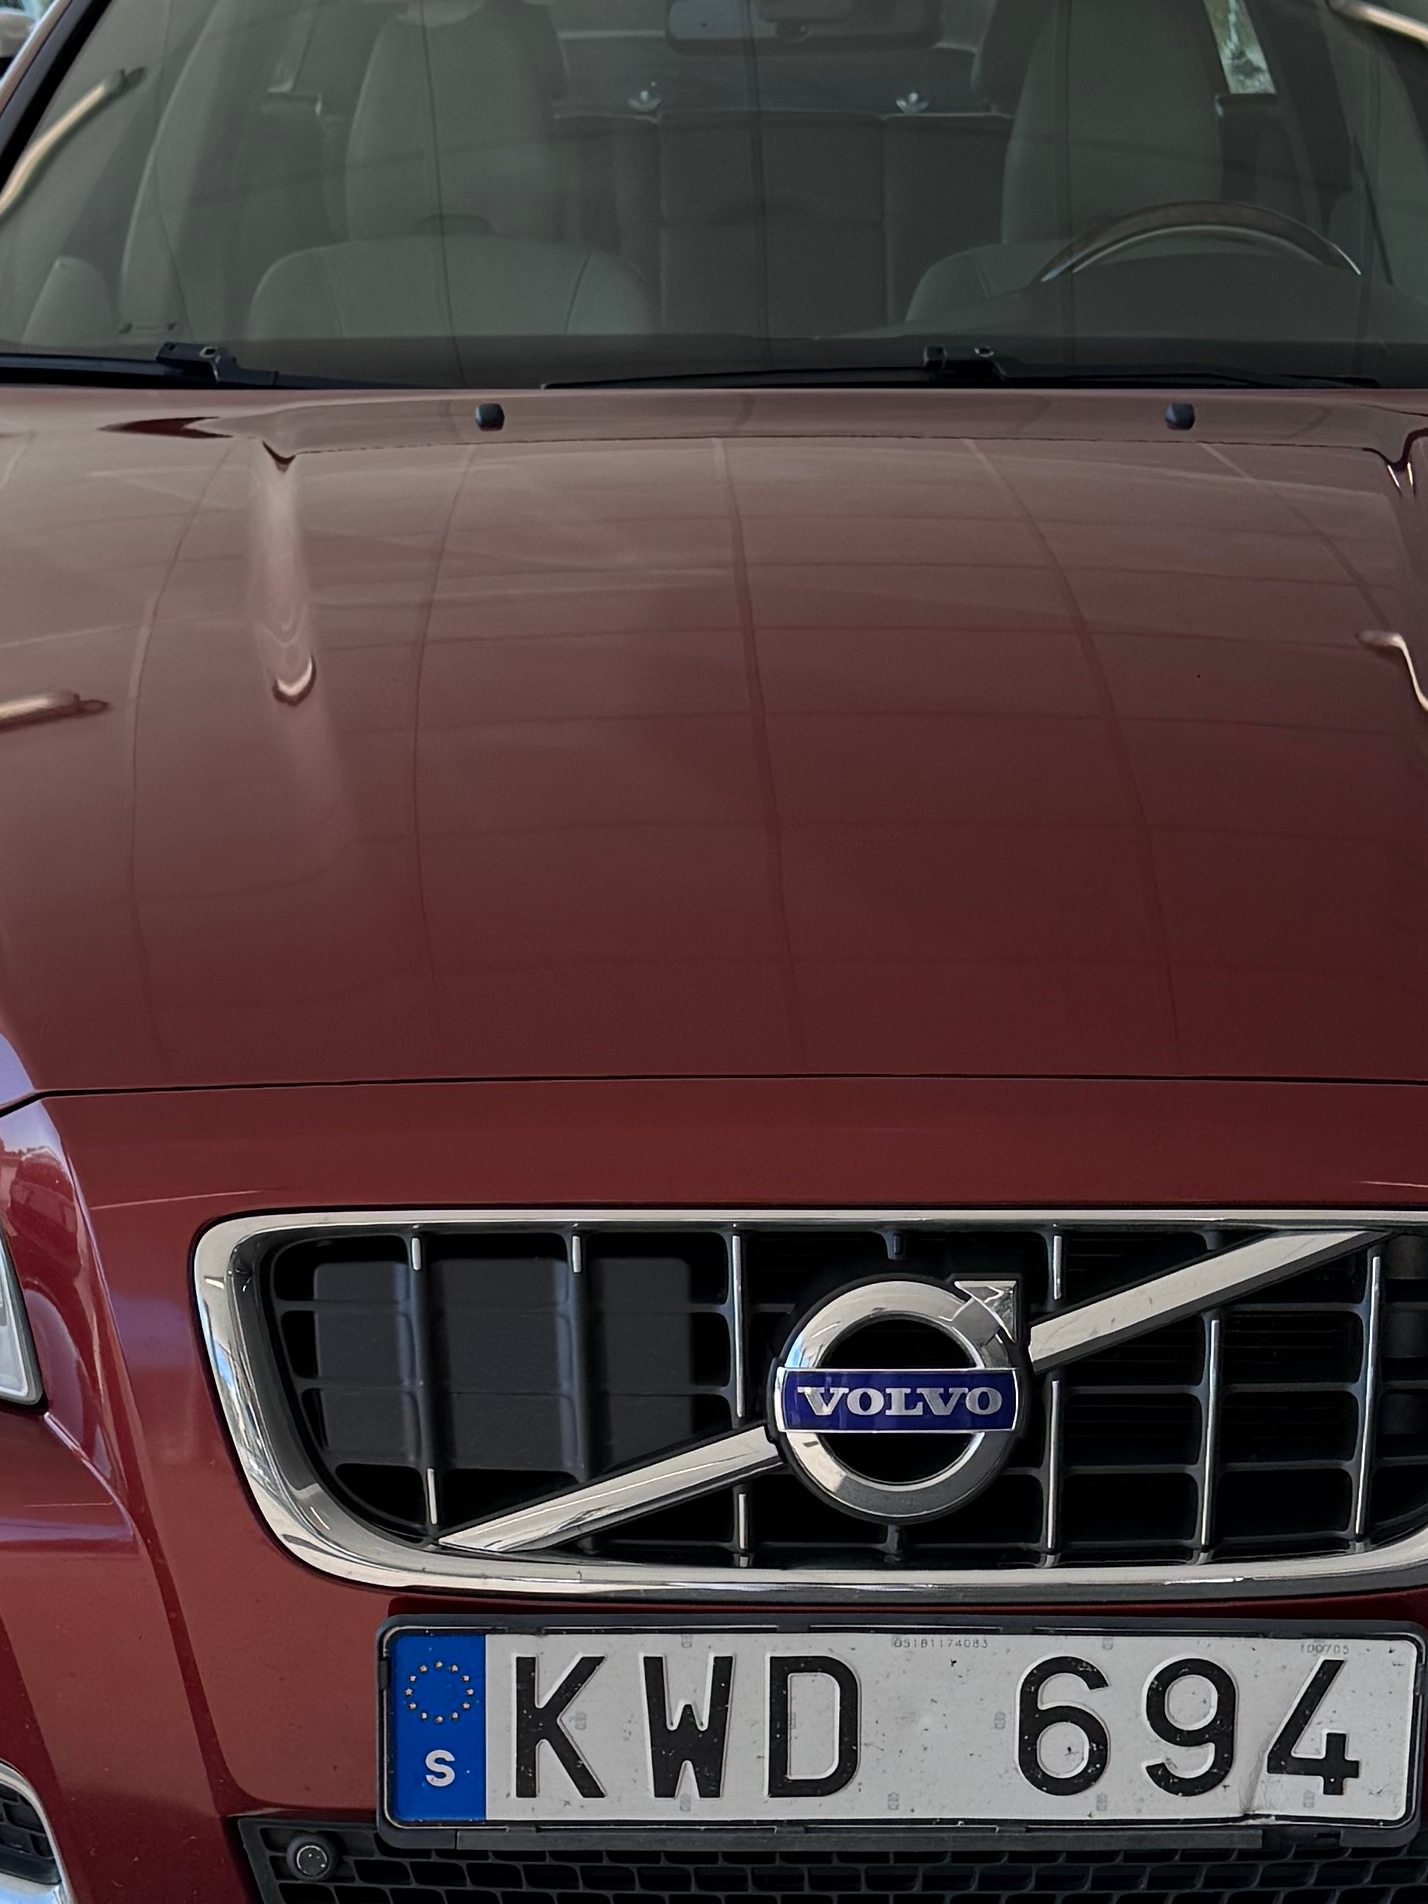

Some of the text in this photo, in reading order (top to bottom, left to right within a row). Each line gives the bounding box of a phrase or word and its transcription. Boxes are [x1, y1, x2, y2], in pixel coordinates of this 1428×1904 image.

[797, 1387, 1003, 1416] VOLVO
[425, 1655, 1361, 1801] S KWD 694
